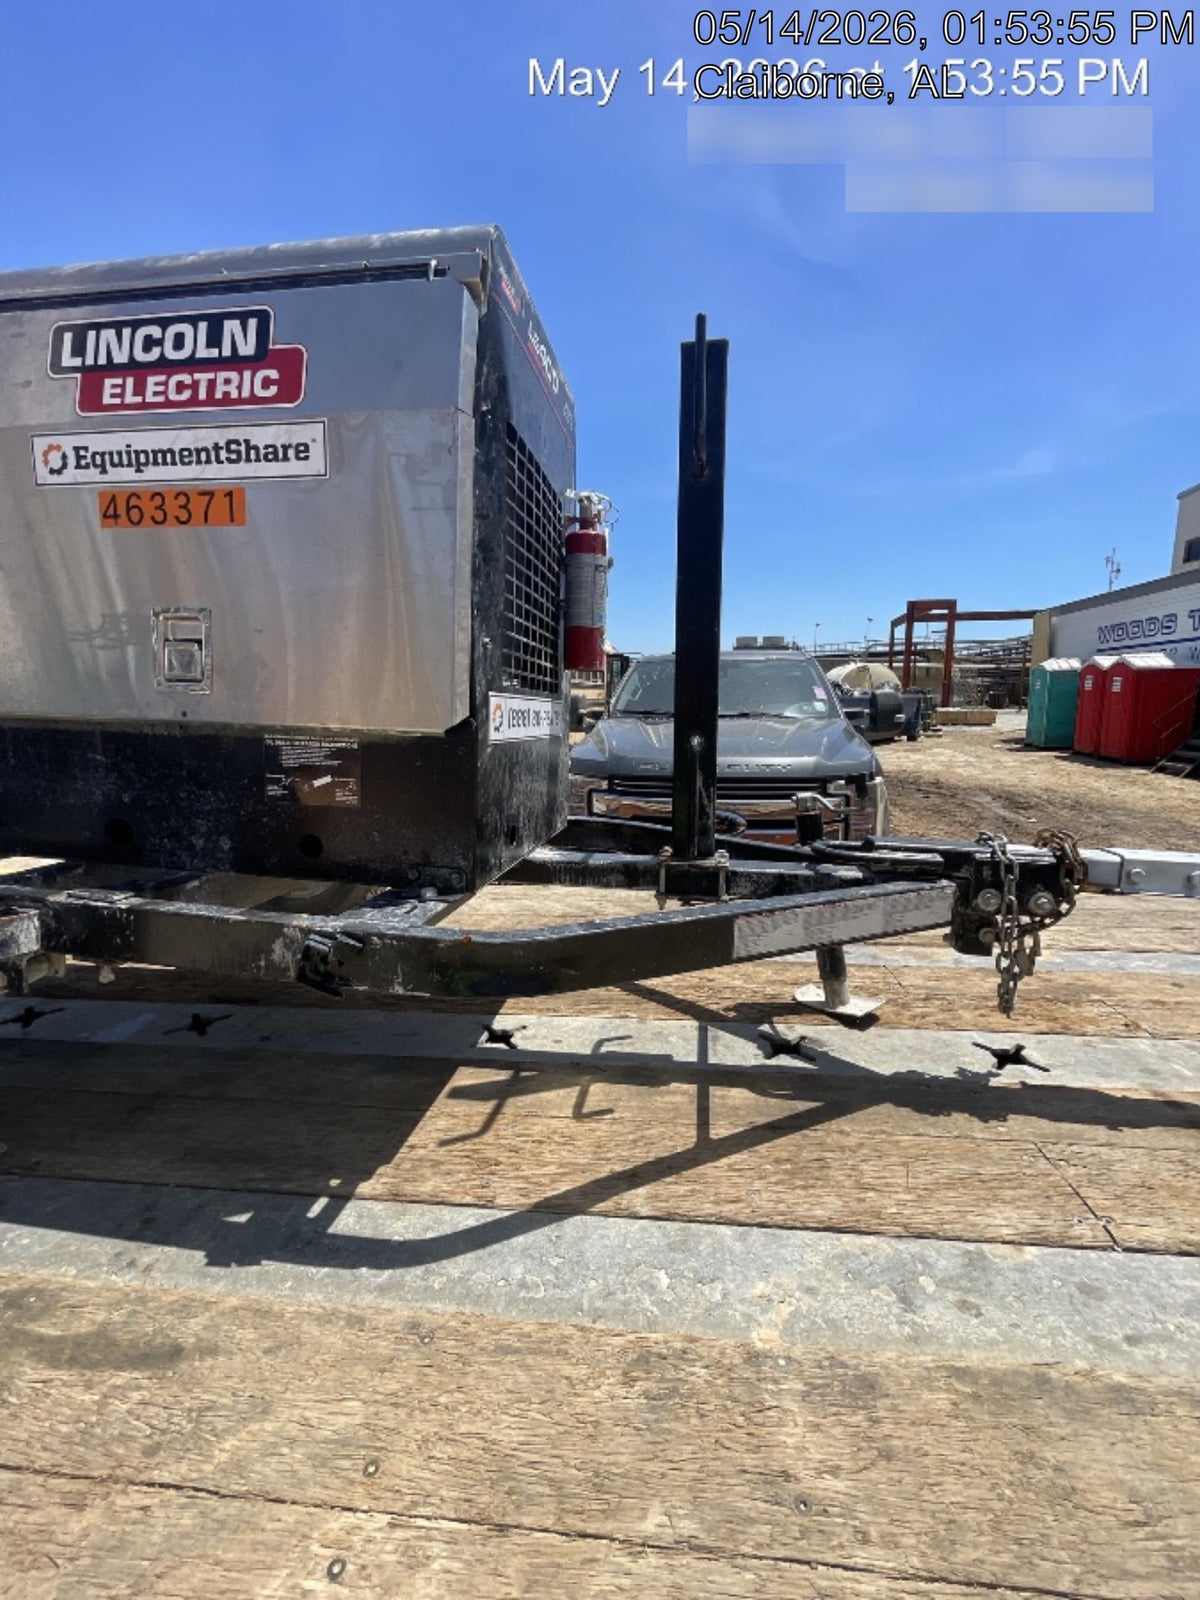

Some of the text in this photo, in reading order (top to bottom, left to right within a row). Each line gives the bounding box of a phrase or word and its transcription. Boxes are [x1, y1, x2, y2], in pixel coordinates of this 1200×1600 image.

[61, 318, 258, 367] LINCOLN
[102, 369, 279, 405] ELECTRIC
[72, 438, 310, 475] EquipmentShare
[102, 490, 234, 526] 463371
[1097, 612, 1178, 644] WOODS
